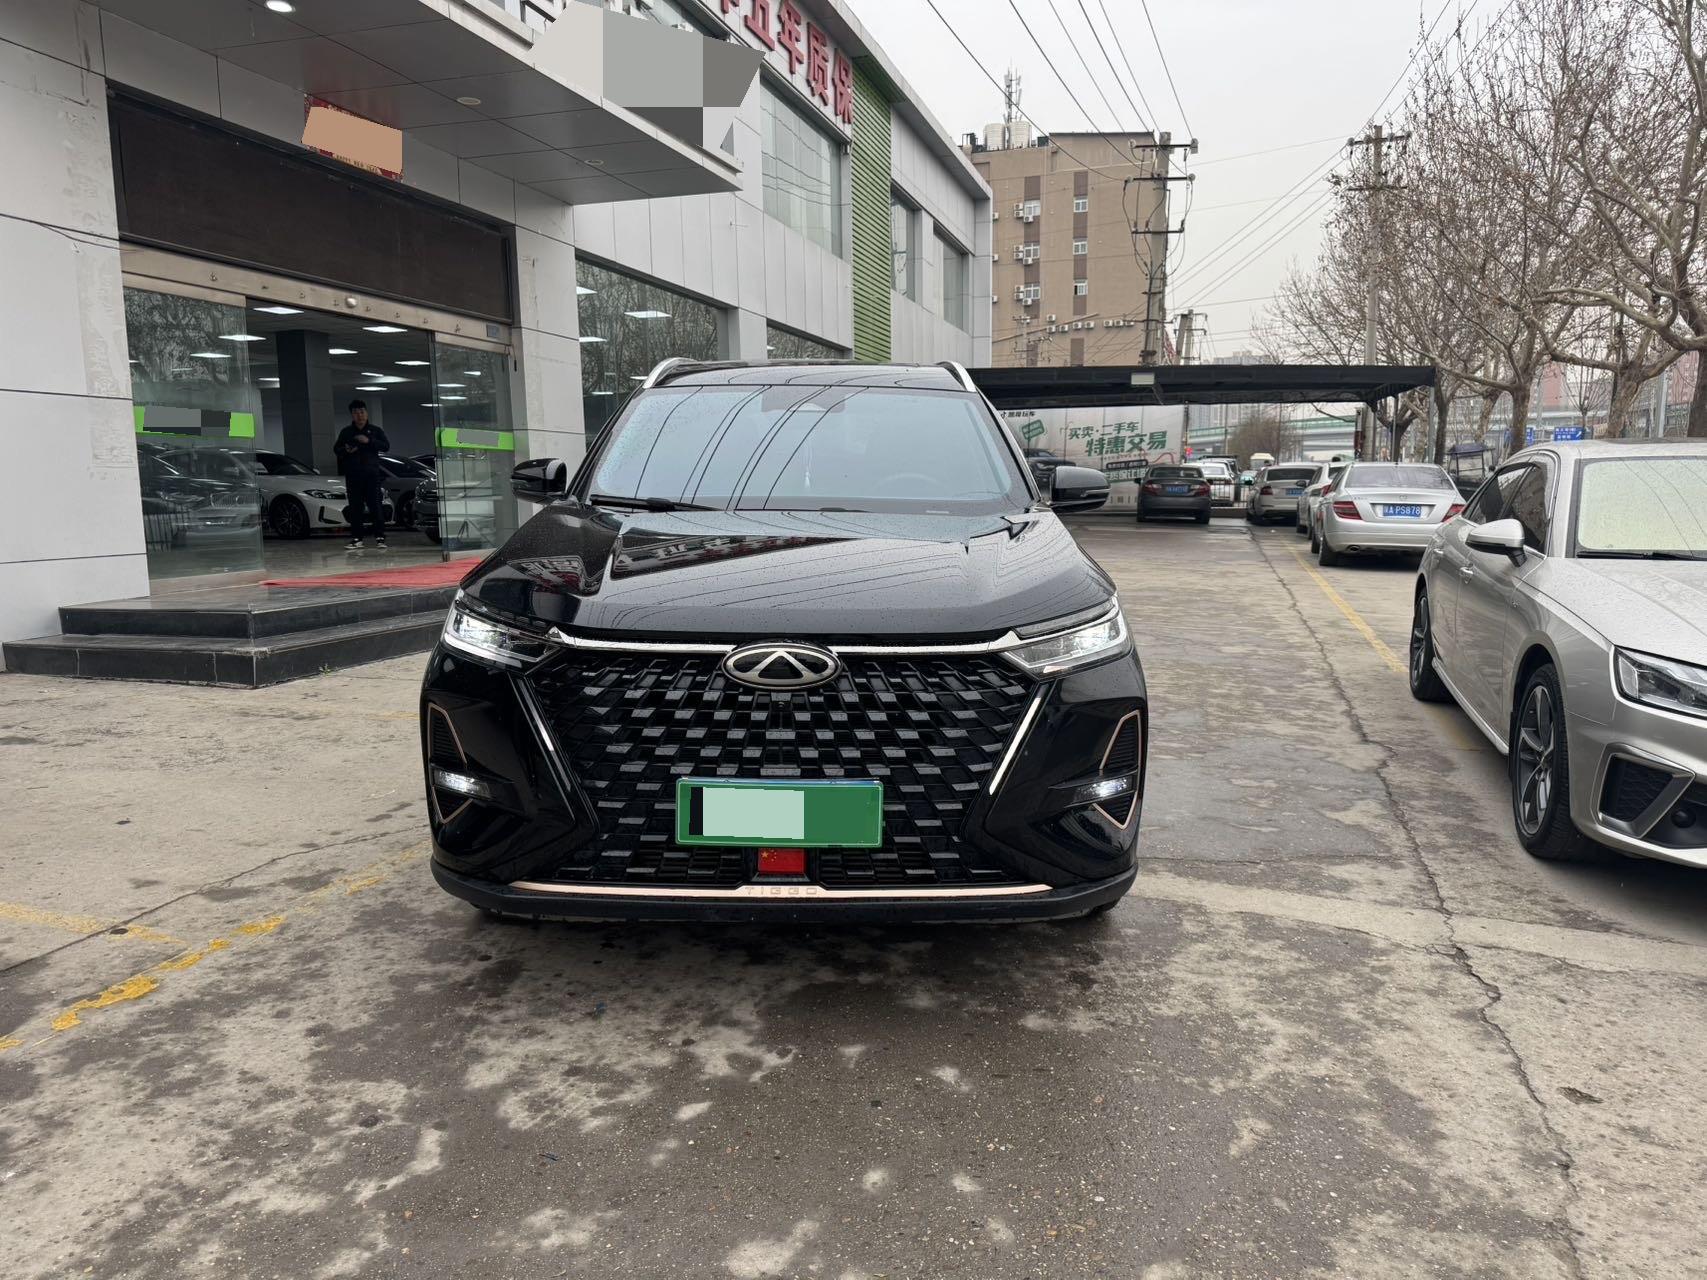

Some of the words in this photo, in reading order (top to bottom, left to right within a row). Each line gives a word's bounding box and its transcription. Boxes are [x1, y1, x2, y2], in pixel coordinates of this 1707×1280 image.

[720, 0, 853, 125] 五年质保
[1085, 430, 1167, 456] 特惠交易
[745, 887, 817, 895] TIGGO
